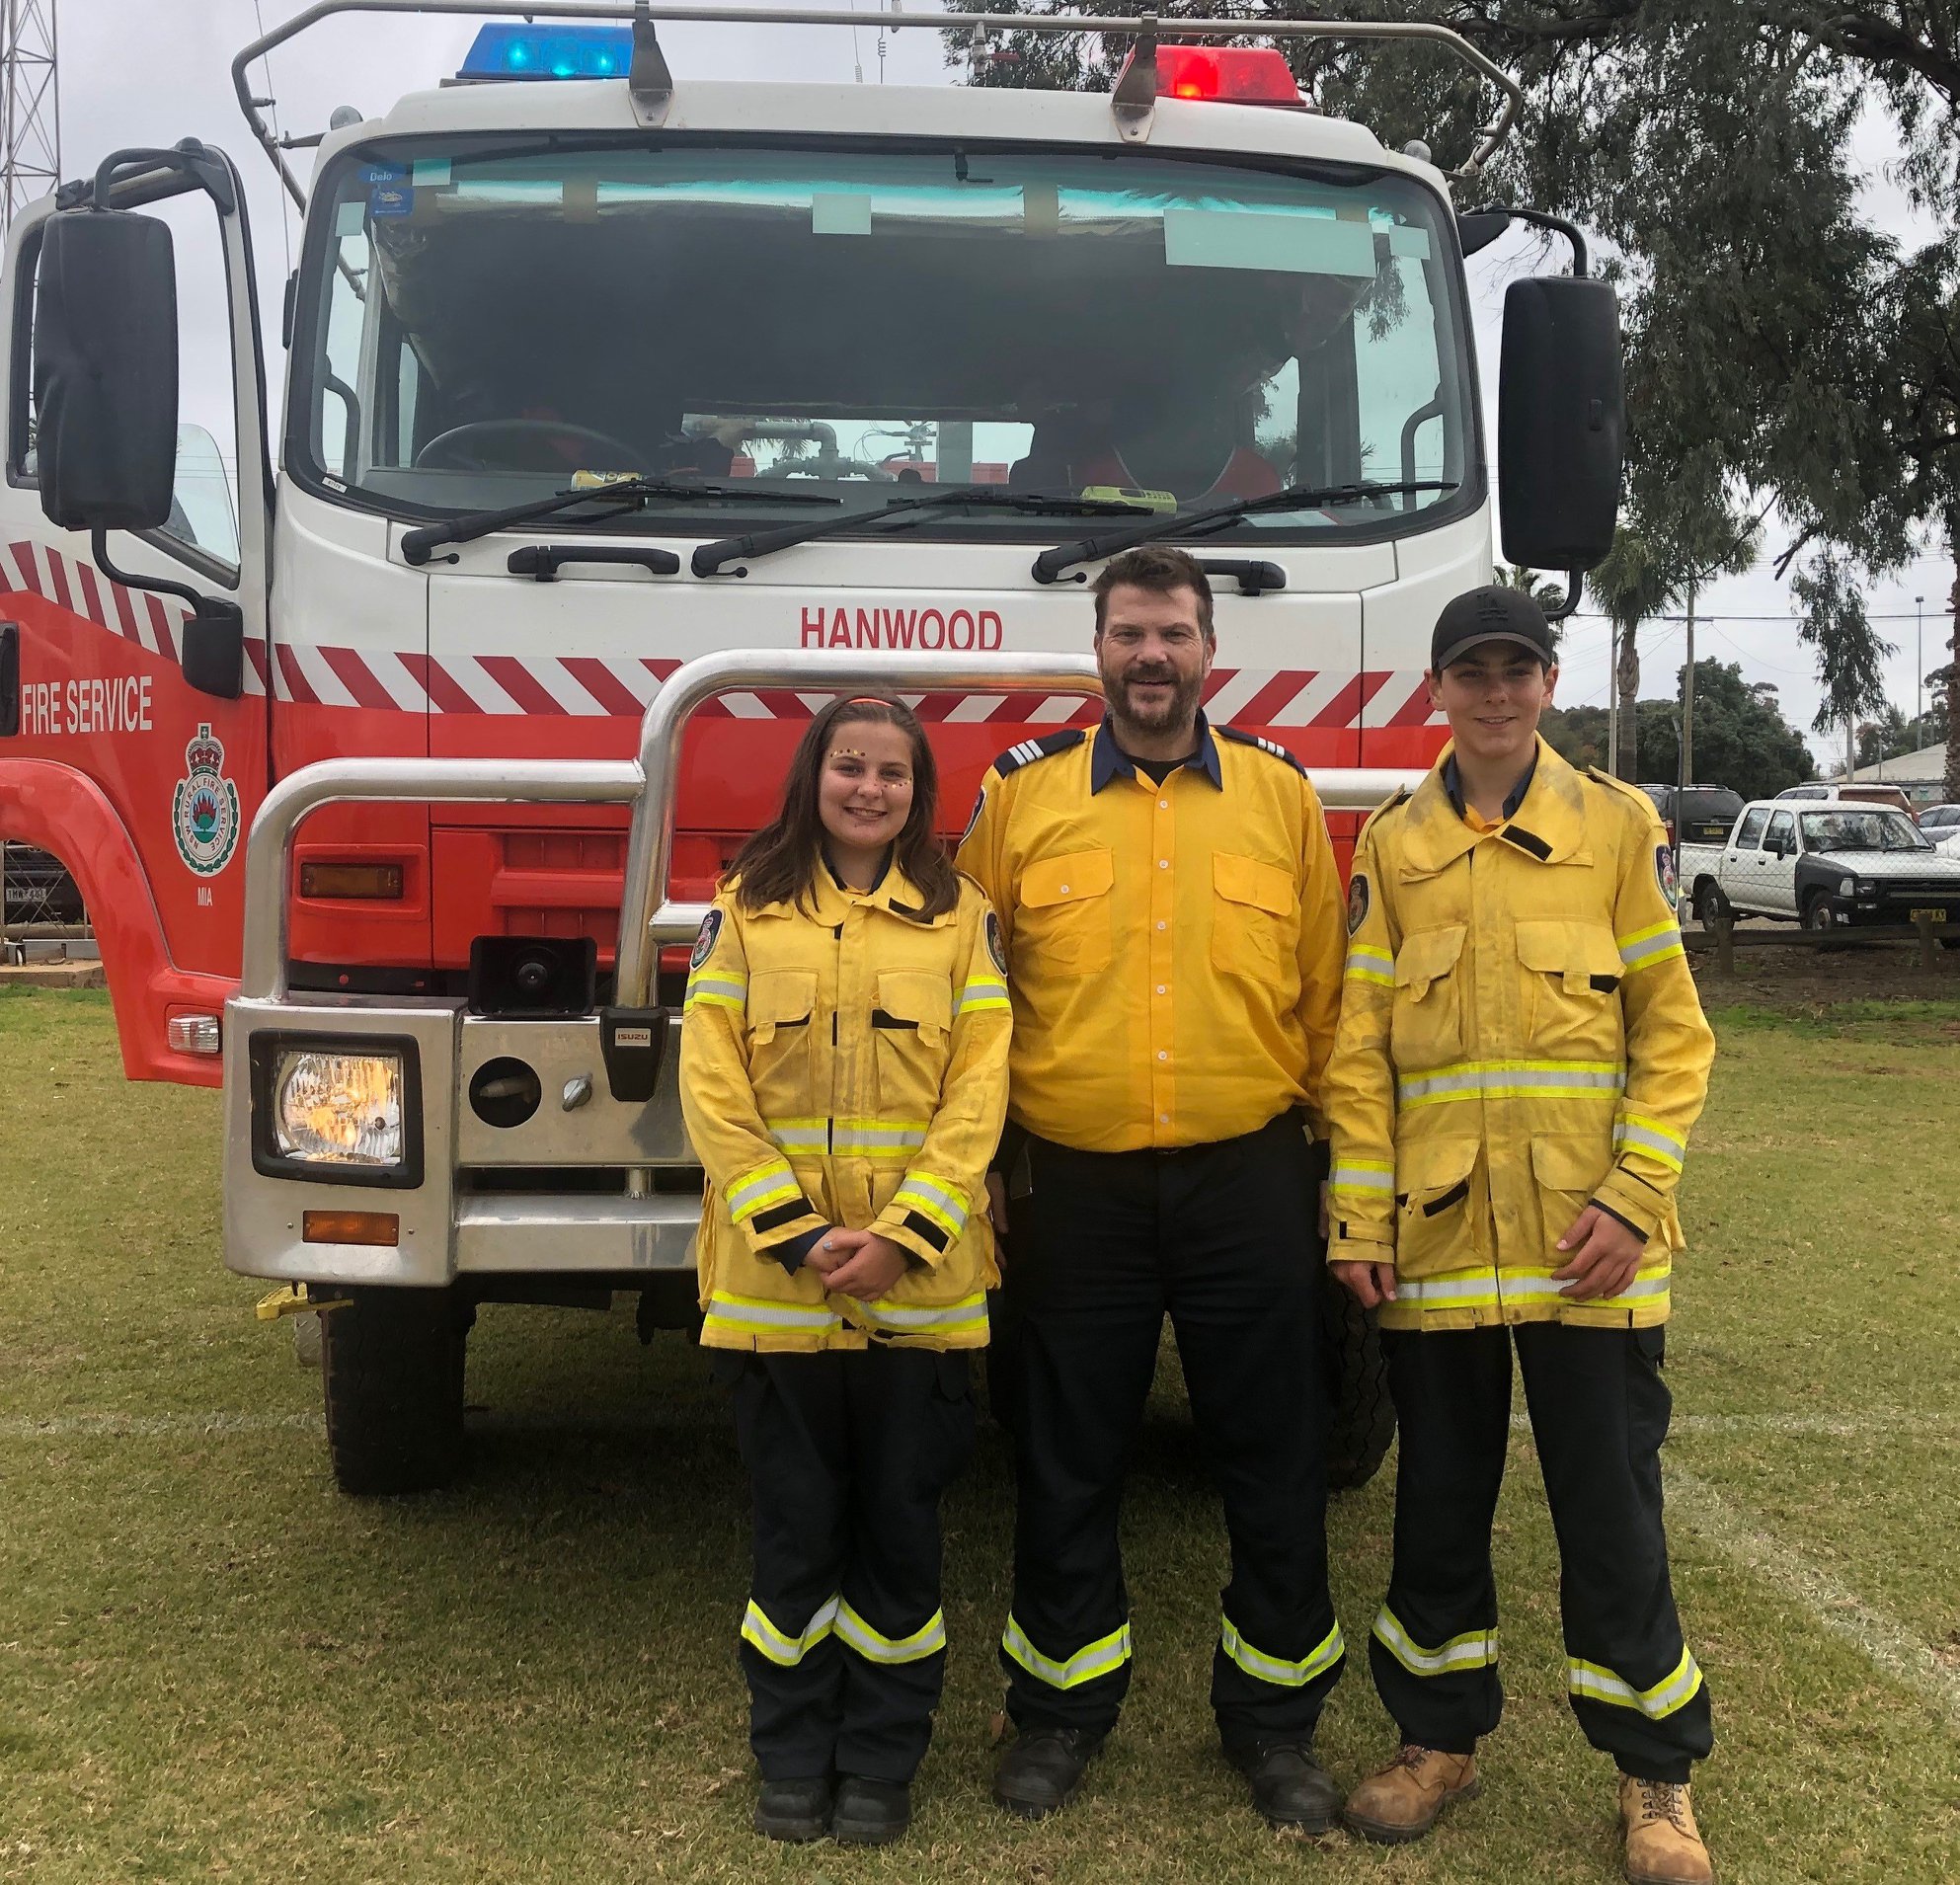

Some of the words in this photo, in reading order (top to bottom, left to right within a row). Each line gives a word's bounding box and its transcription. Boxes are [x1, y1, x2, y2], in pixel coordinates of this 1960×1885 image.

[369, 172, 393, 183] Delo
[801, 606, 1003, 651] HANWOOD
[22, 681, 62, 735] FIRE
[66, 675, 153, 734] SERVICE
[184, 781, 201, 819] RURAL
[202, 777, 220, 794] FIRE
[185, 825, 199, 850] NSW
[209, 797, 227, 851] SERVICE
[197, 887, 213, 906] MIA
